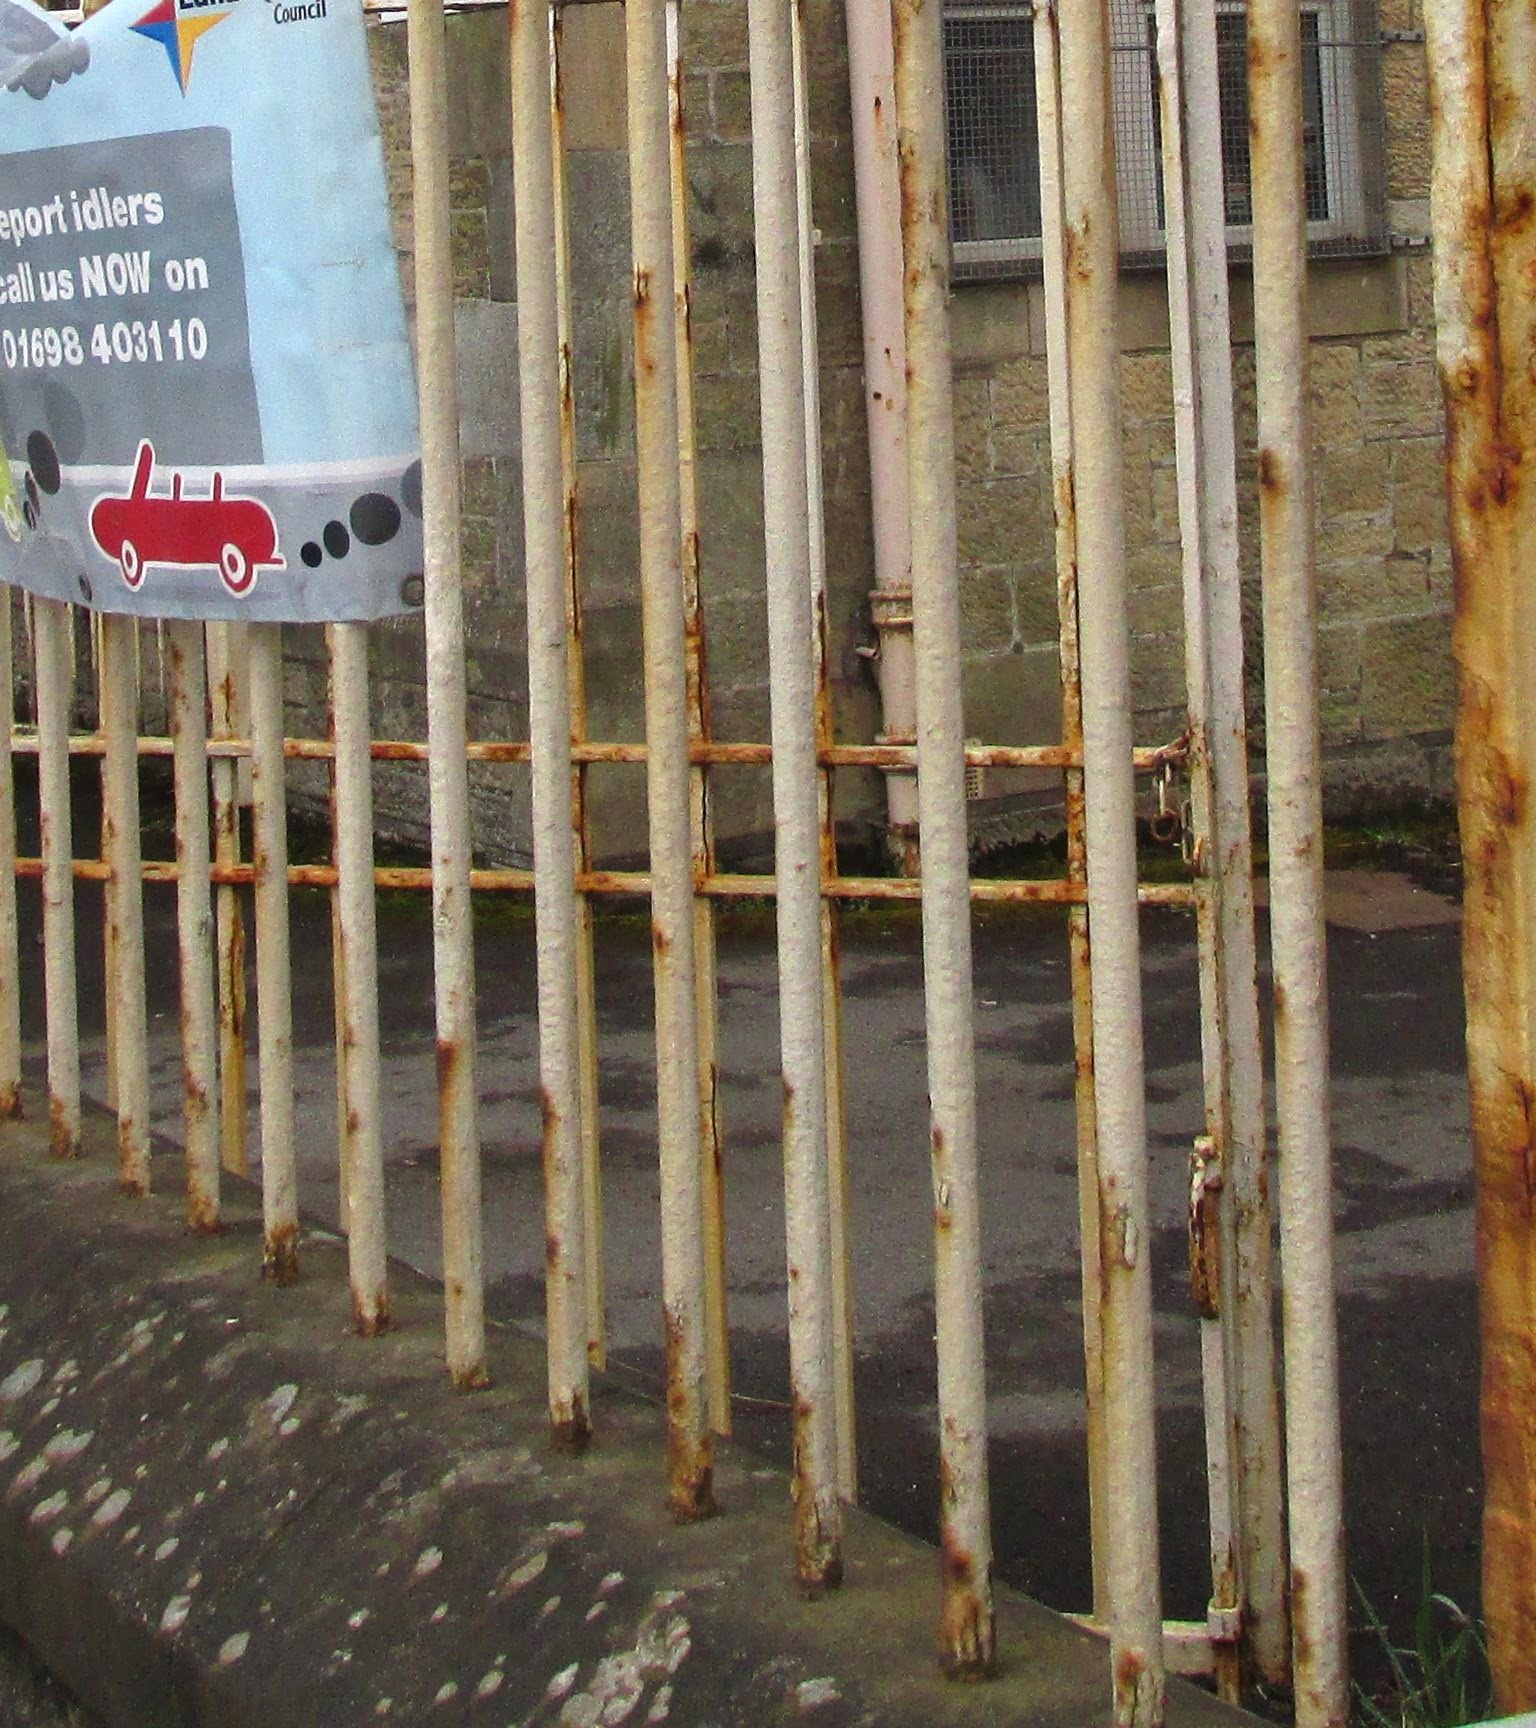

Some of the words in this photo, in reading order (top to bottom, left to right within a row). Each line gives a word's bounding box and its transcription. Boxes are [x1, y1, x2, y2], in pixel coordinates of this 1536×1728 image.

[70, 186, 165, 232] idlers
[39, 268, 75, 303] us
[79, 249, 151, 299] NOW
[164, 255, 210, 293] on
[2, 325, 85, 369] 01698
[90, 317, 209, 365] 403110
